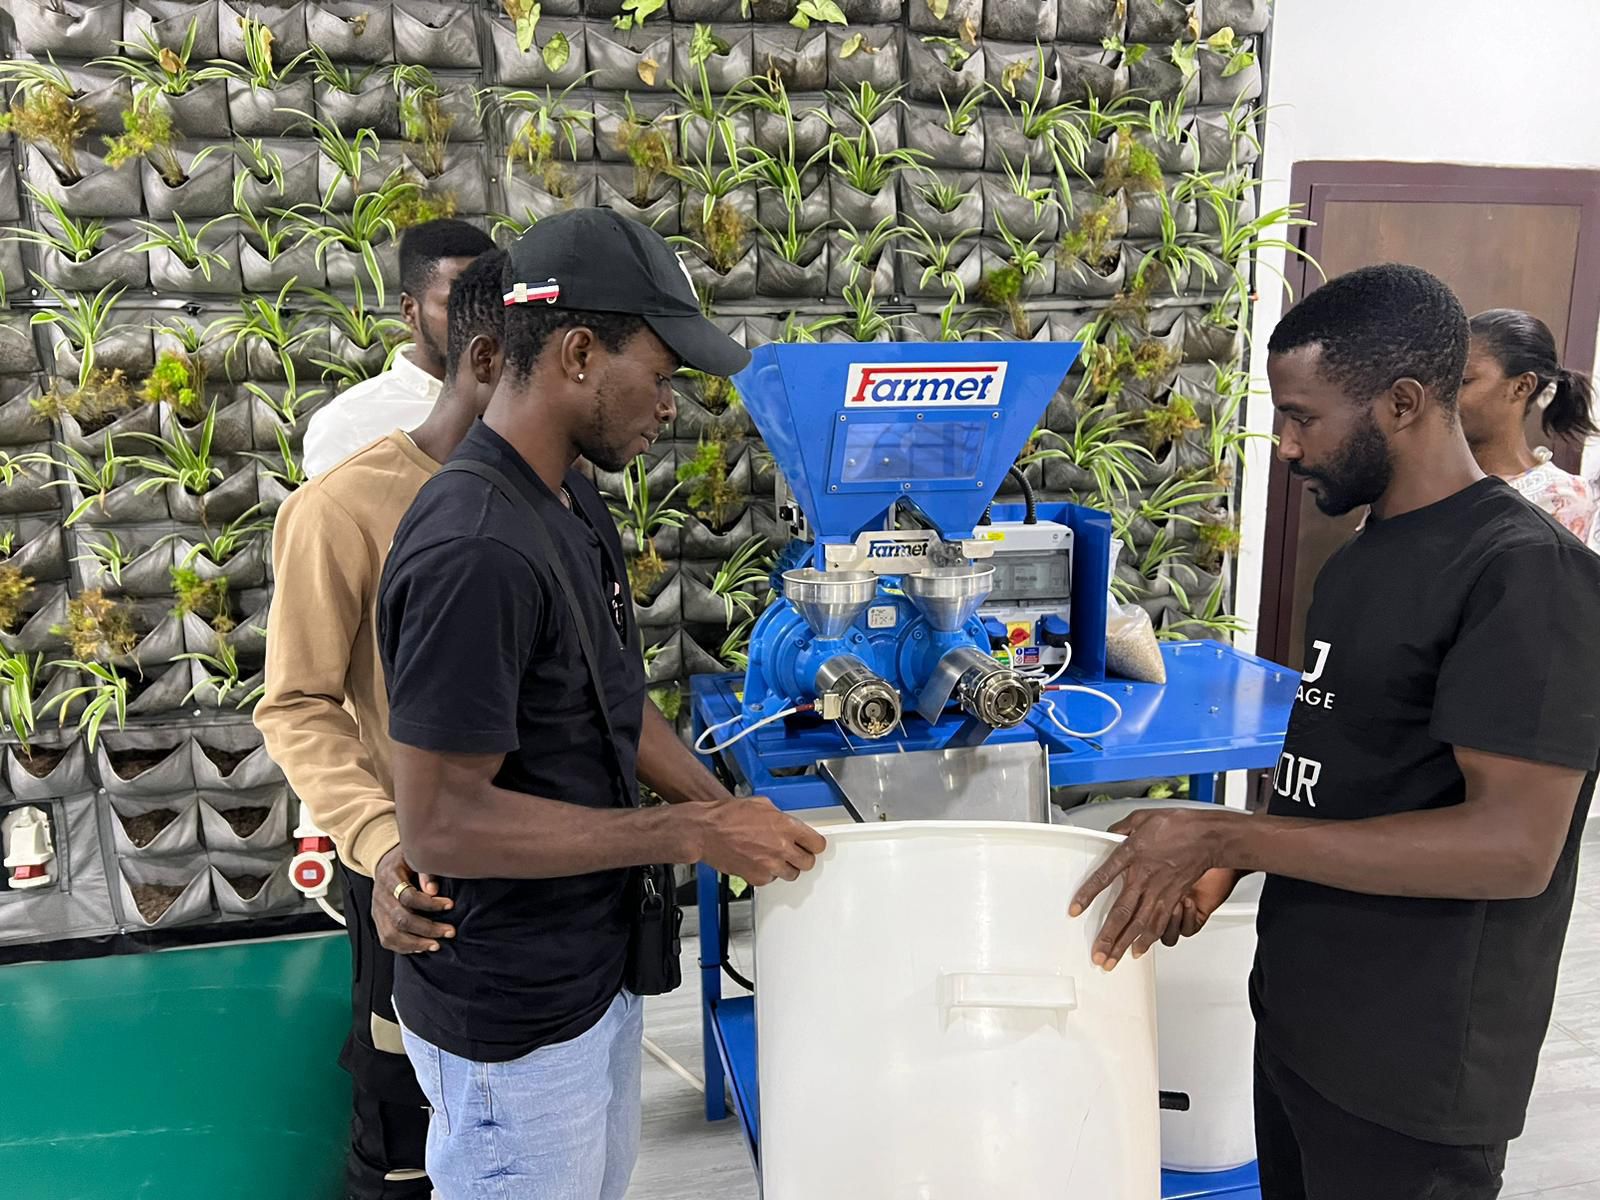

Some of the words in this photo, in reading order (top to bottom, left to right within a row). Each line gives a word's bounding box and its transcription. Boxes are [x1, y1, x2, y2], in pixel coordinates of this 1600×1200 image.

[851, 366, 999, 402] Farmet
[867, 538, 930, 558] Farmet
[1273, 751, 1322, 808] OR
